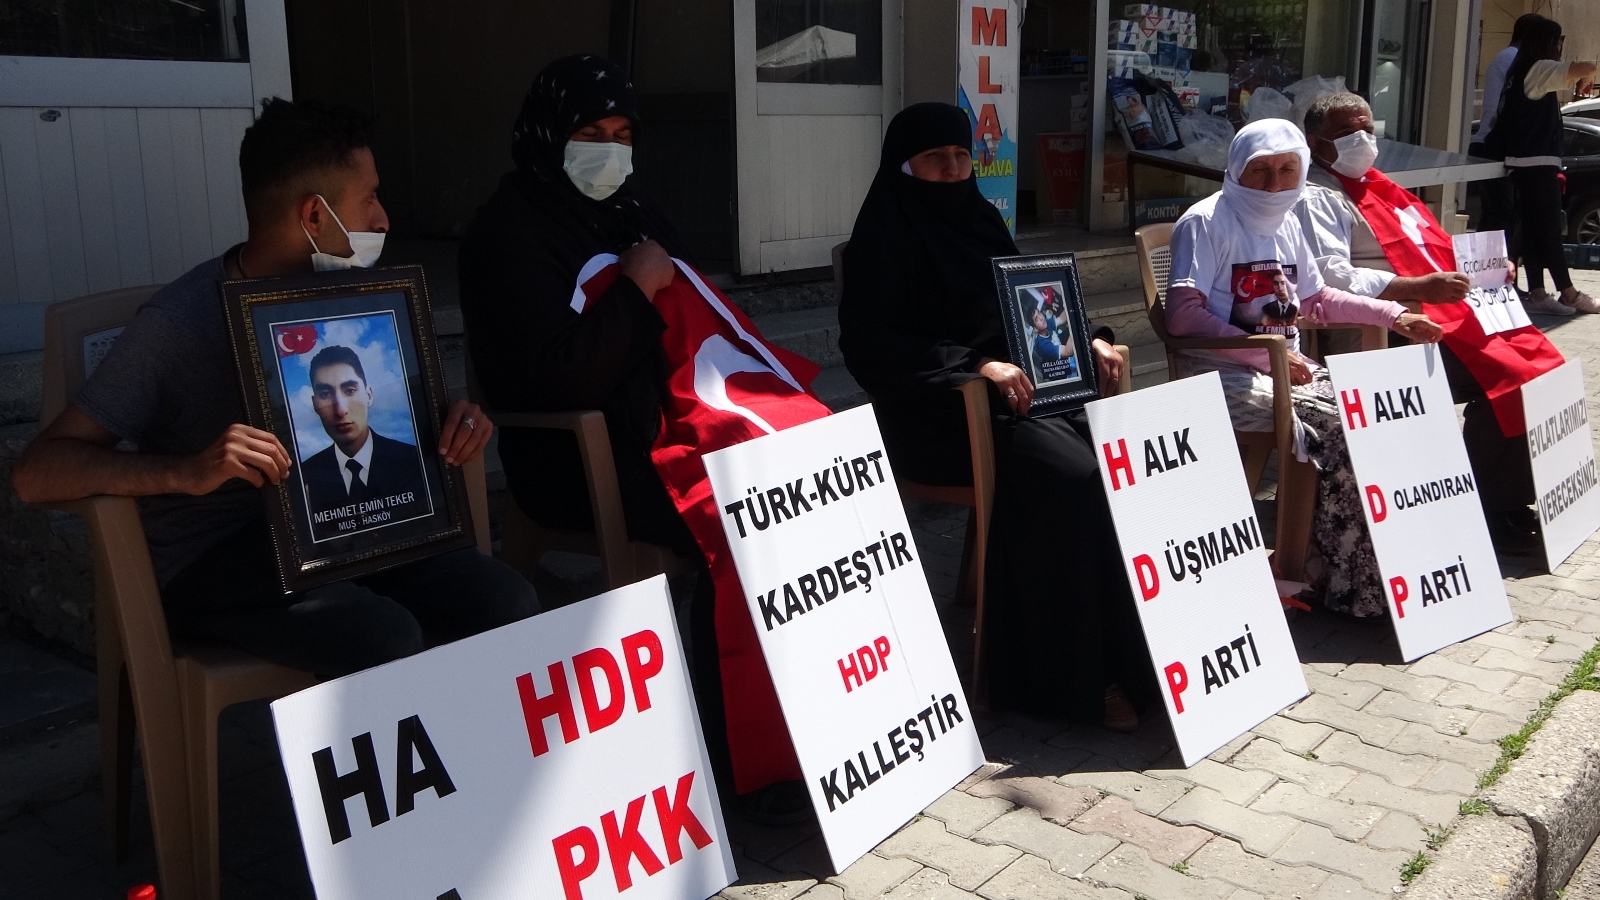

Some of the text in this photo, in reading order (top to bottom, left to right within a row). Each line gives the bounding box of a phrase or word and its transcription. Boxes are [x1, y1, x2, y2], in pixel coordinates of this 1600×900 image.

[1374, 385, 1426, 424] ALKI
[1528, 397, 1588, 459] EVLATLARIMIZI
[1144, 427, 1198, 477] ALK
[314, 491, 415, 524] MEHMET EMİN TEKER
[338, 519, 357, 531] MUŞ
[361, 511, 391, 526] HASKÖY
[725, 449, 886, 539] TÜRK-KÜRT
[1393, 472, 1475, 511] OLANDIRAN
[1539, 455, 1598, 526] VERECEKSİNİZ
[757, 530, 914, 632] KARDEŞTİR
[1164, 516, 1261, 584] ÜŞMANI
[1420, 554, 1472, 608] ARTİ
[837, 635, 892, 693] HDP
[1201, 623, 1262, 695] ARTİ
[311, 629, 664, 845] HA HDP
[819, 693, 964, 813] KALLEŞTİR
[552, 770, 714, 900] PKK
